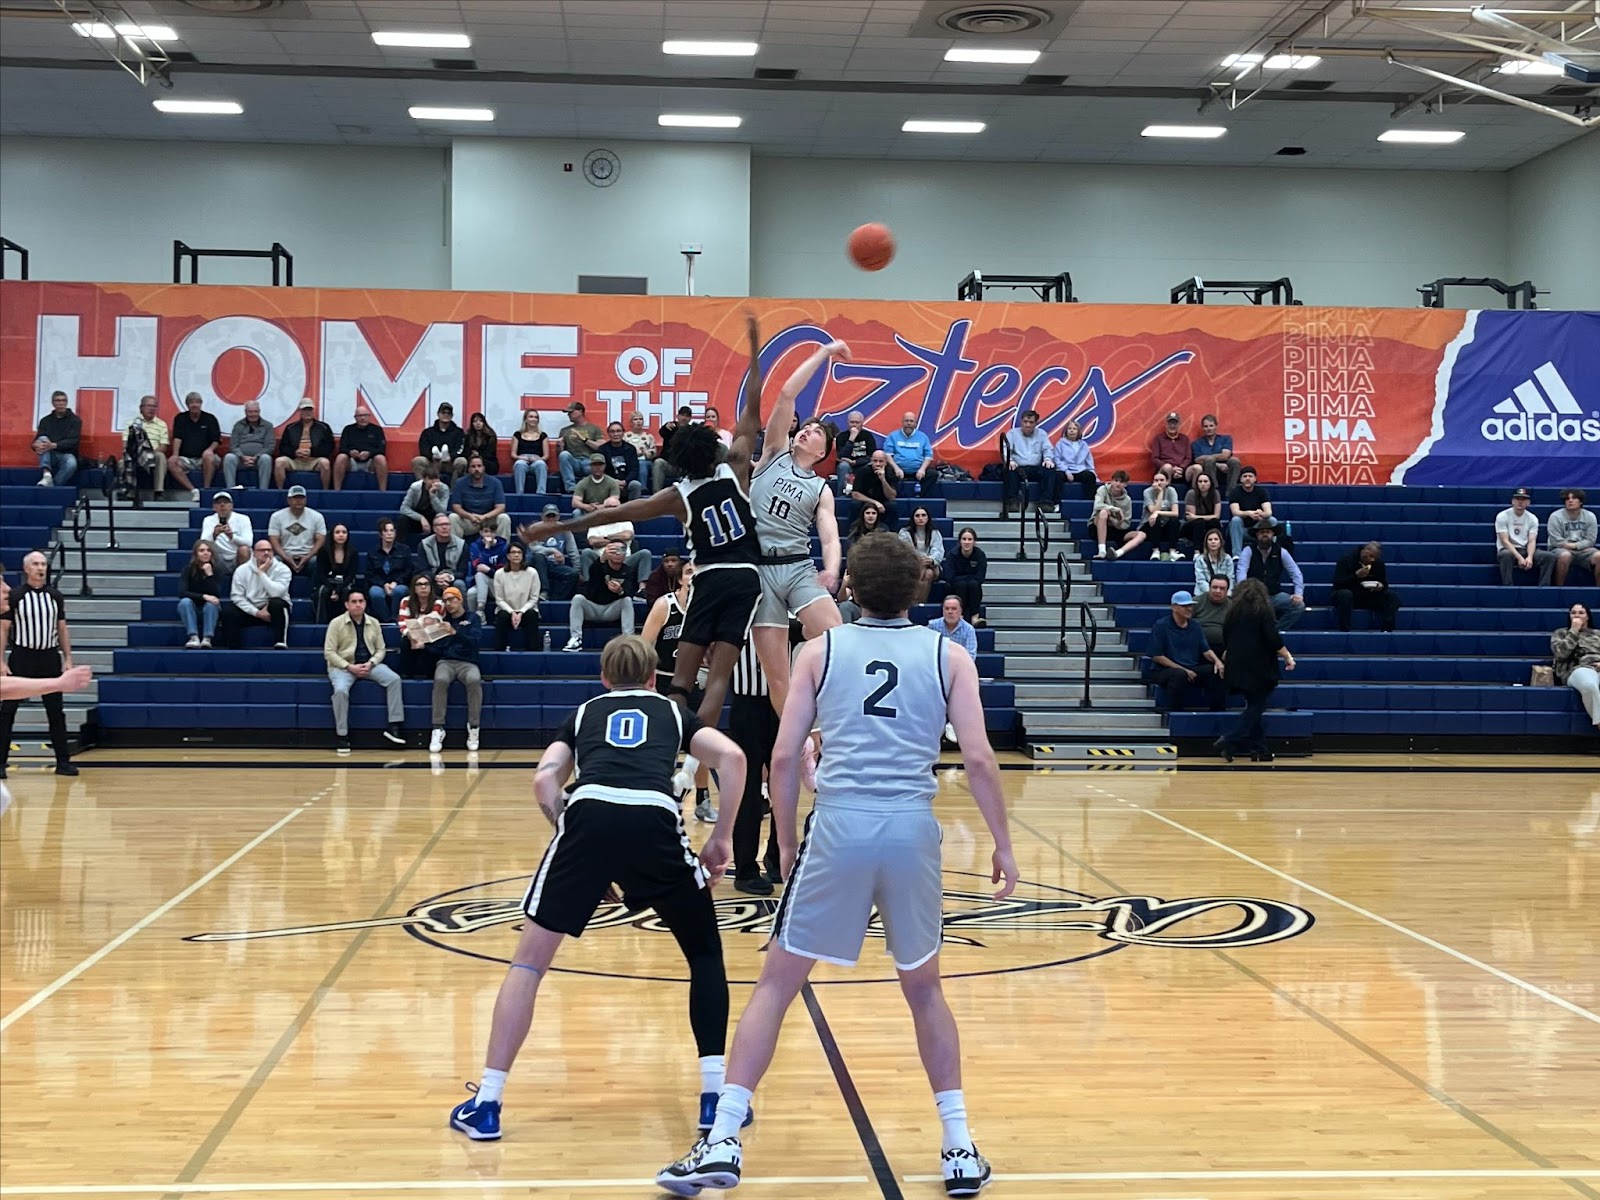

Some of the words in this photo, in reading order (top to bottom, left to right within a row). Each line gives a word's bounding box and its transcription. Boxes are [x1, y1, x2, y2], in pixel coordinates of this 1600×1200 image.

[1283, 322, 1375, 346] PIMA
[615, 346, 694, 387] OF
[1283, 346, 1375, 370] PIMA
[32, 314, 583, 439] HOME
[1283, 370, 1376, 394] PIMA
[596, 390, 709, 429] THE
[1284, 394, 1376, 418] PIMA
[1284, 418, 1377, 441] PIMA
[1480, 411, 1600, 442] adidas
[1285, 441, 1379, 465] PIMA
[1285, 465, 1377, 486] PIMA
[772, 477, 803, 502] PIMA
[768, 496, 791, 520] 10
[701, 498, 747, 548] 11
[863, 659, 899, 719] 2
[605, 708, 649, 748] 0
